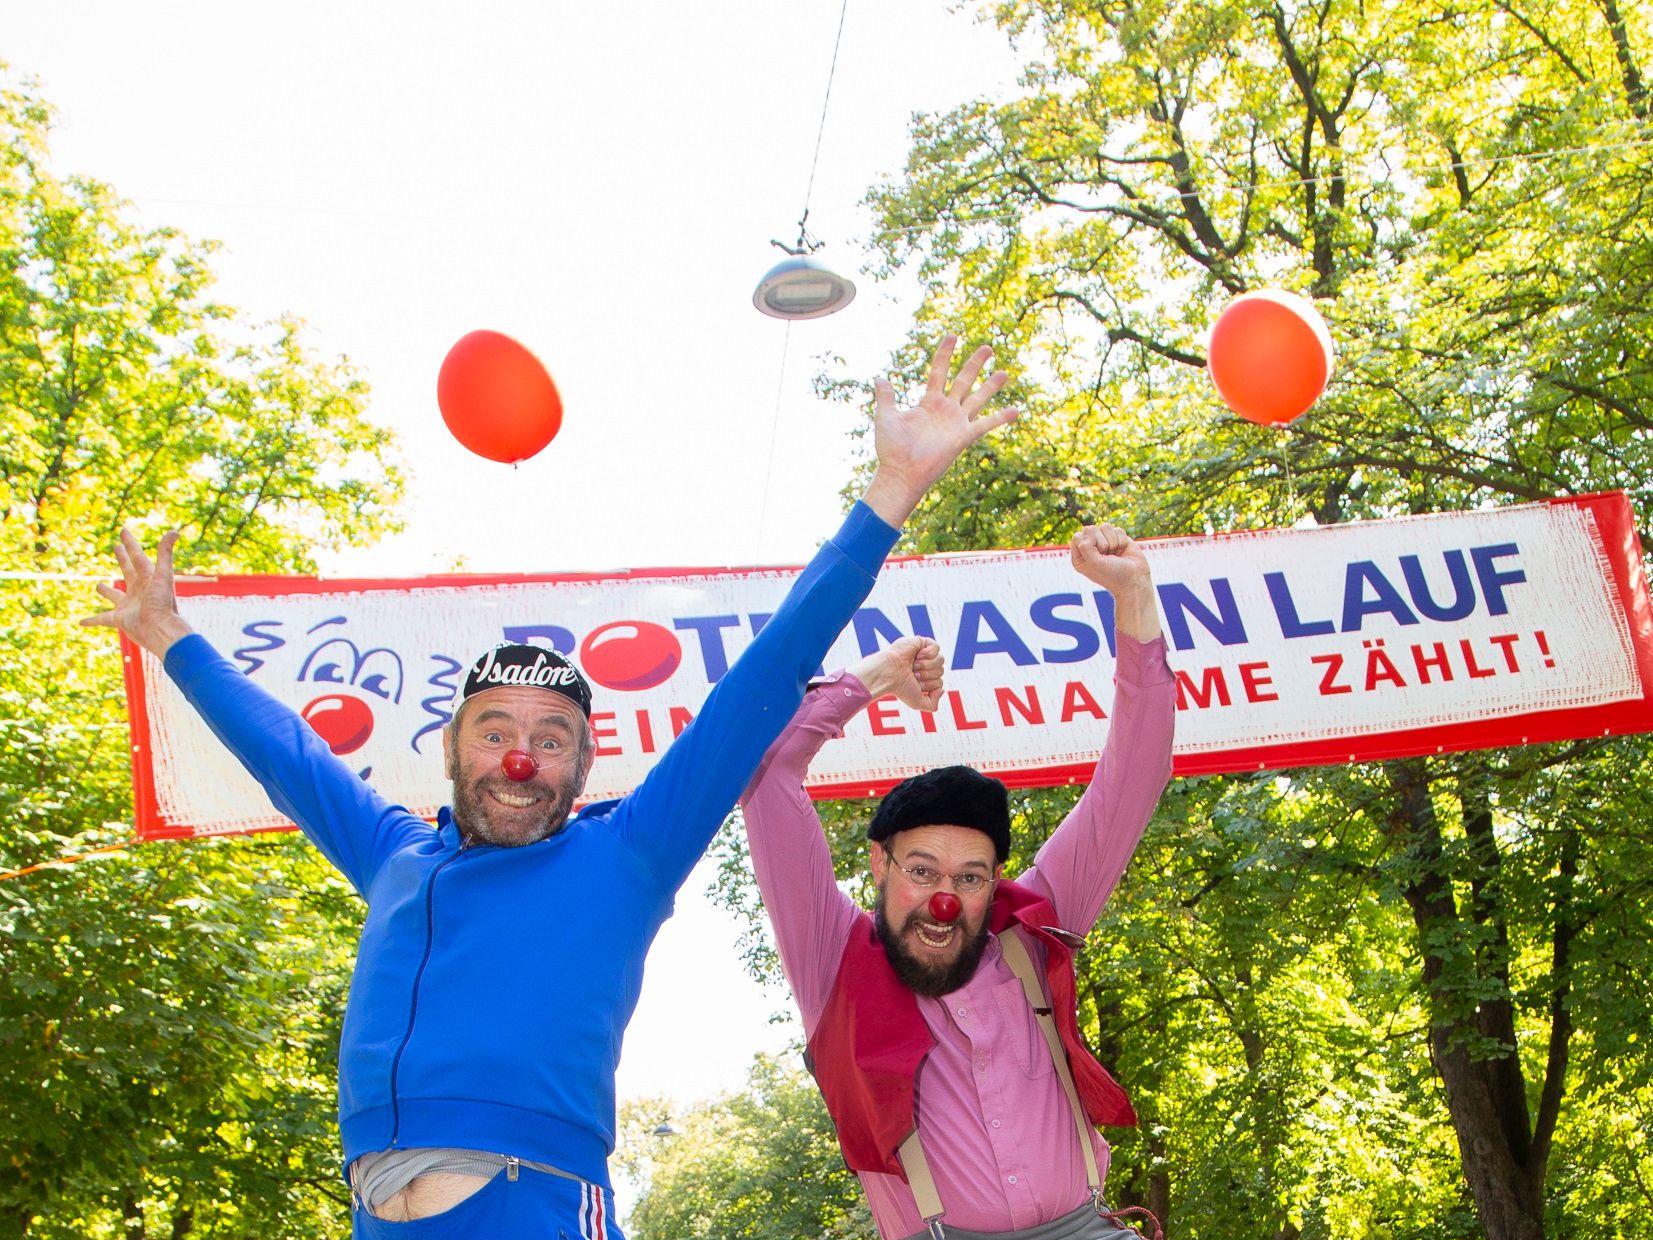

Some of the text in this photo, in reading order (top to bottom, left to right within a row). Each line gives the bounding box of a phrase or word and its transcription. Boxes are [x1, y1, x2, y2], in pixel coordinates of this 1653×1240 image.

[1263, 542, 1527, 639] LAUF
[473, 648, 578, 686] Isadore
[832, 661, 1279, 739] EILNAME
[1311, 630, 1555, 696] ZÄHLT!
